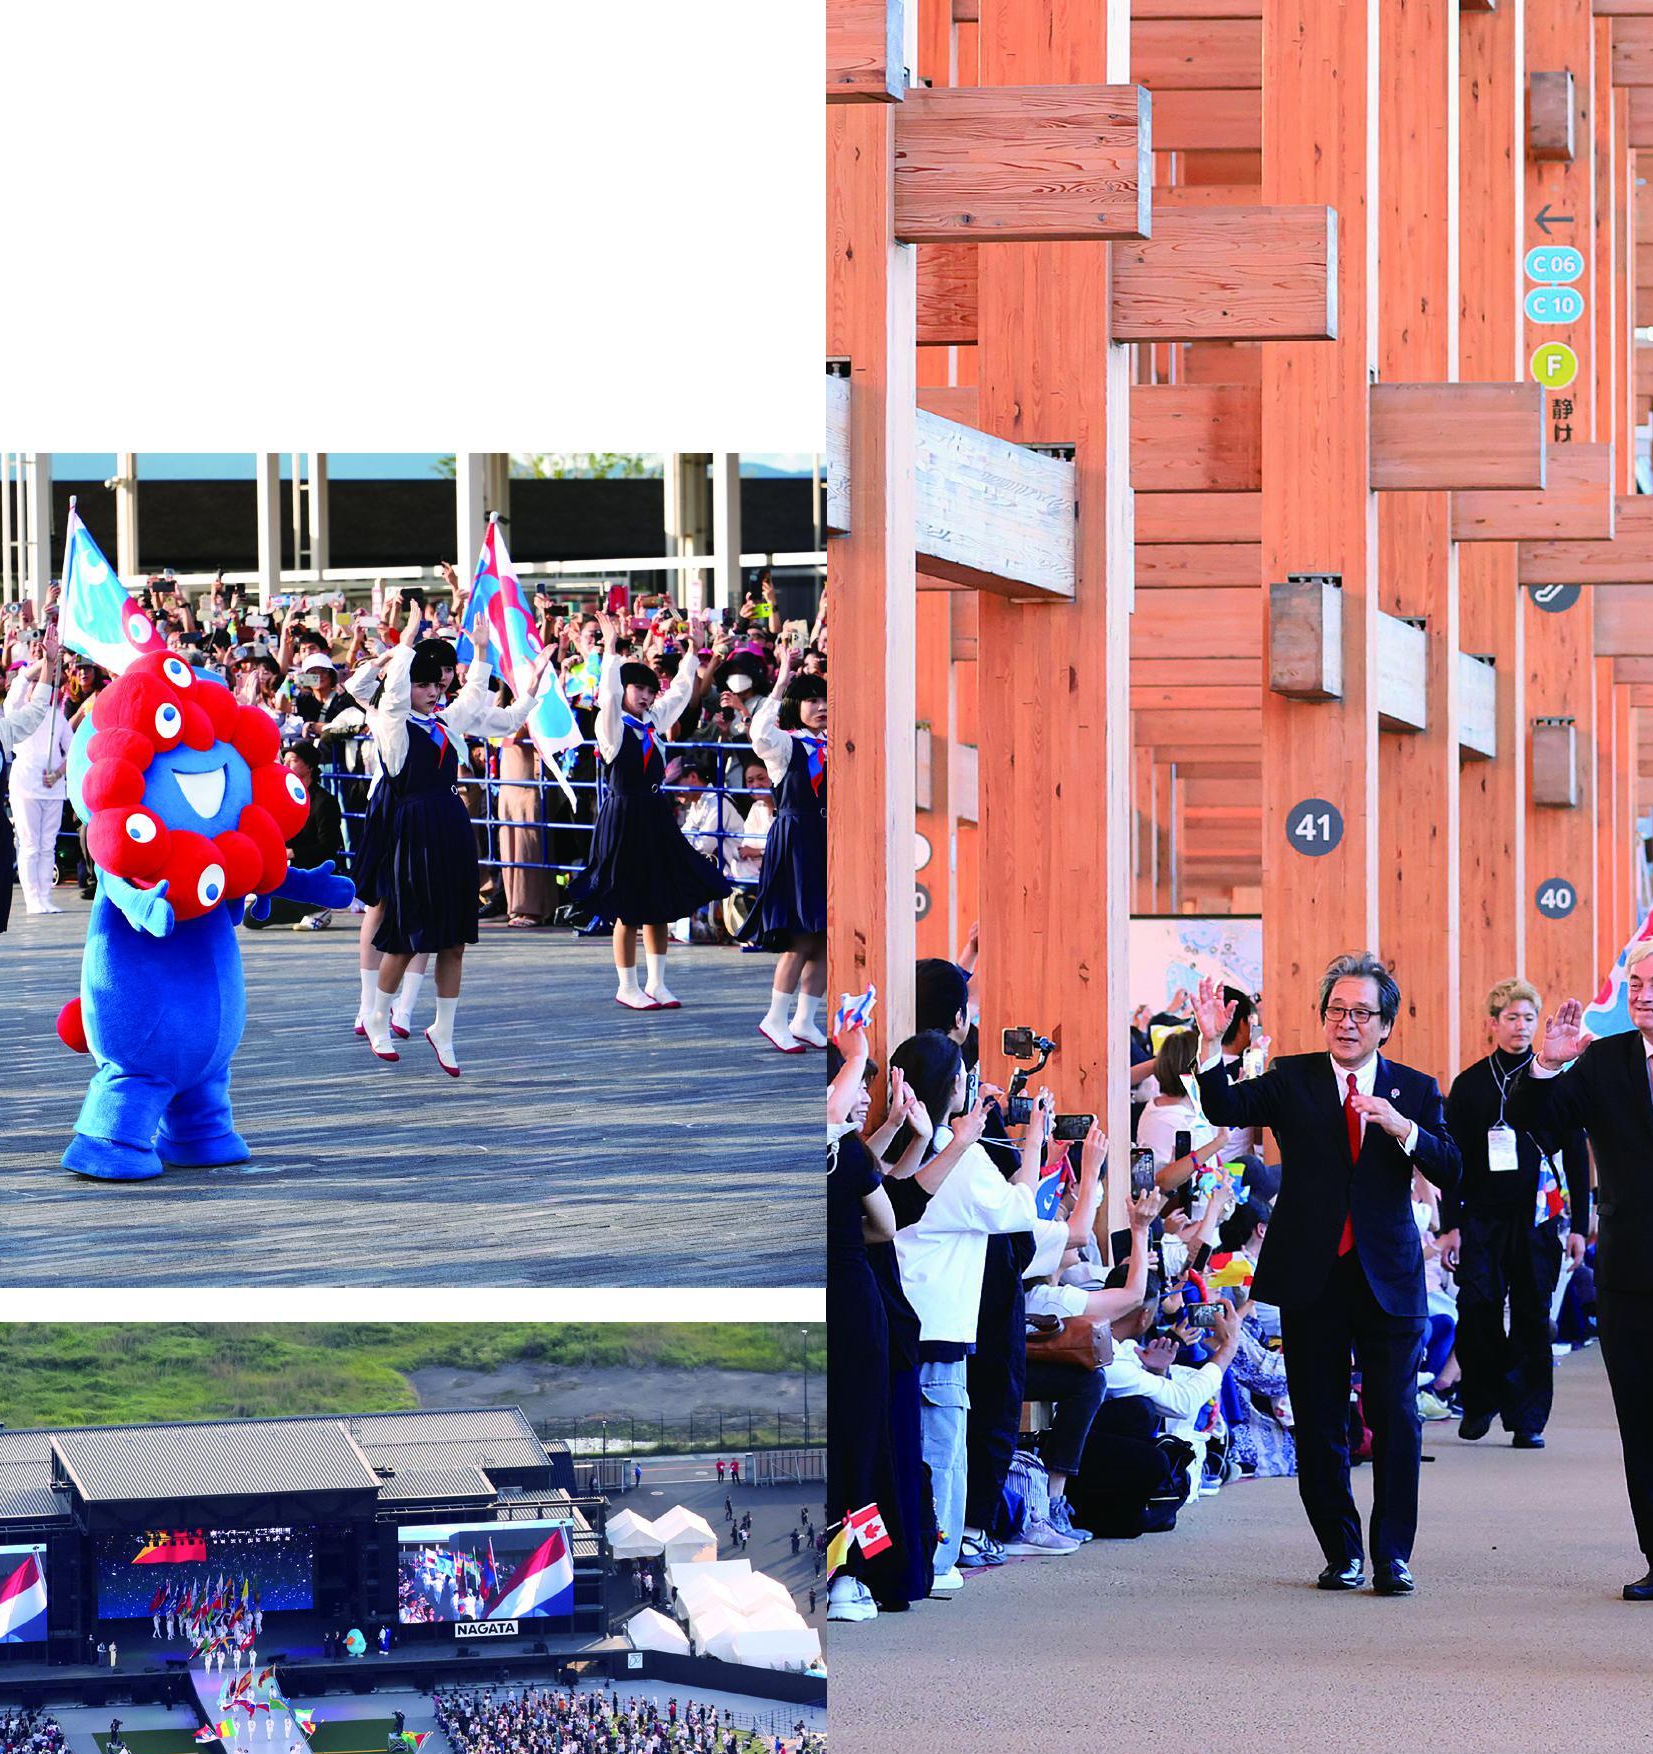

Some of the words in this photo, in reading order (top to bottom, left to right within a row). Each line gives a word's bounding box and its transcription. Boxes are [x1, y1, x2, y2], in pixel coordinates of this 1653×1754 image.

[1533, 256, 1546, 272] C
[1551, 256, 1575, 272] 06
[1533, 297, 1546, 314] C
[1553, 297, 1574, 314] 10
[1547, 355, 1562, 376] F
[1295, 813, 1330, 841] 41
[1540, 888, 1571, 909] 40
[457, 1622, 515, 1635] NAGATA
